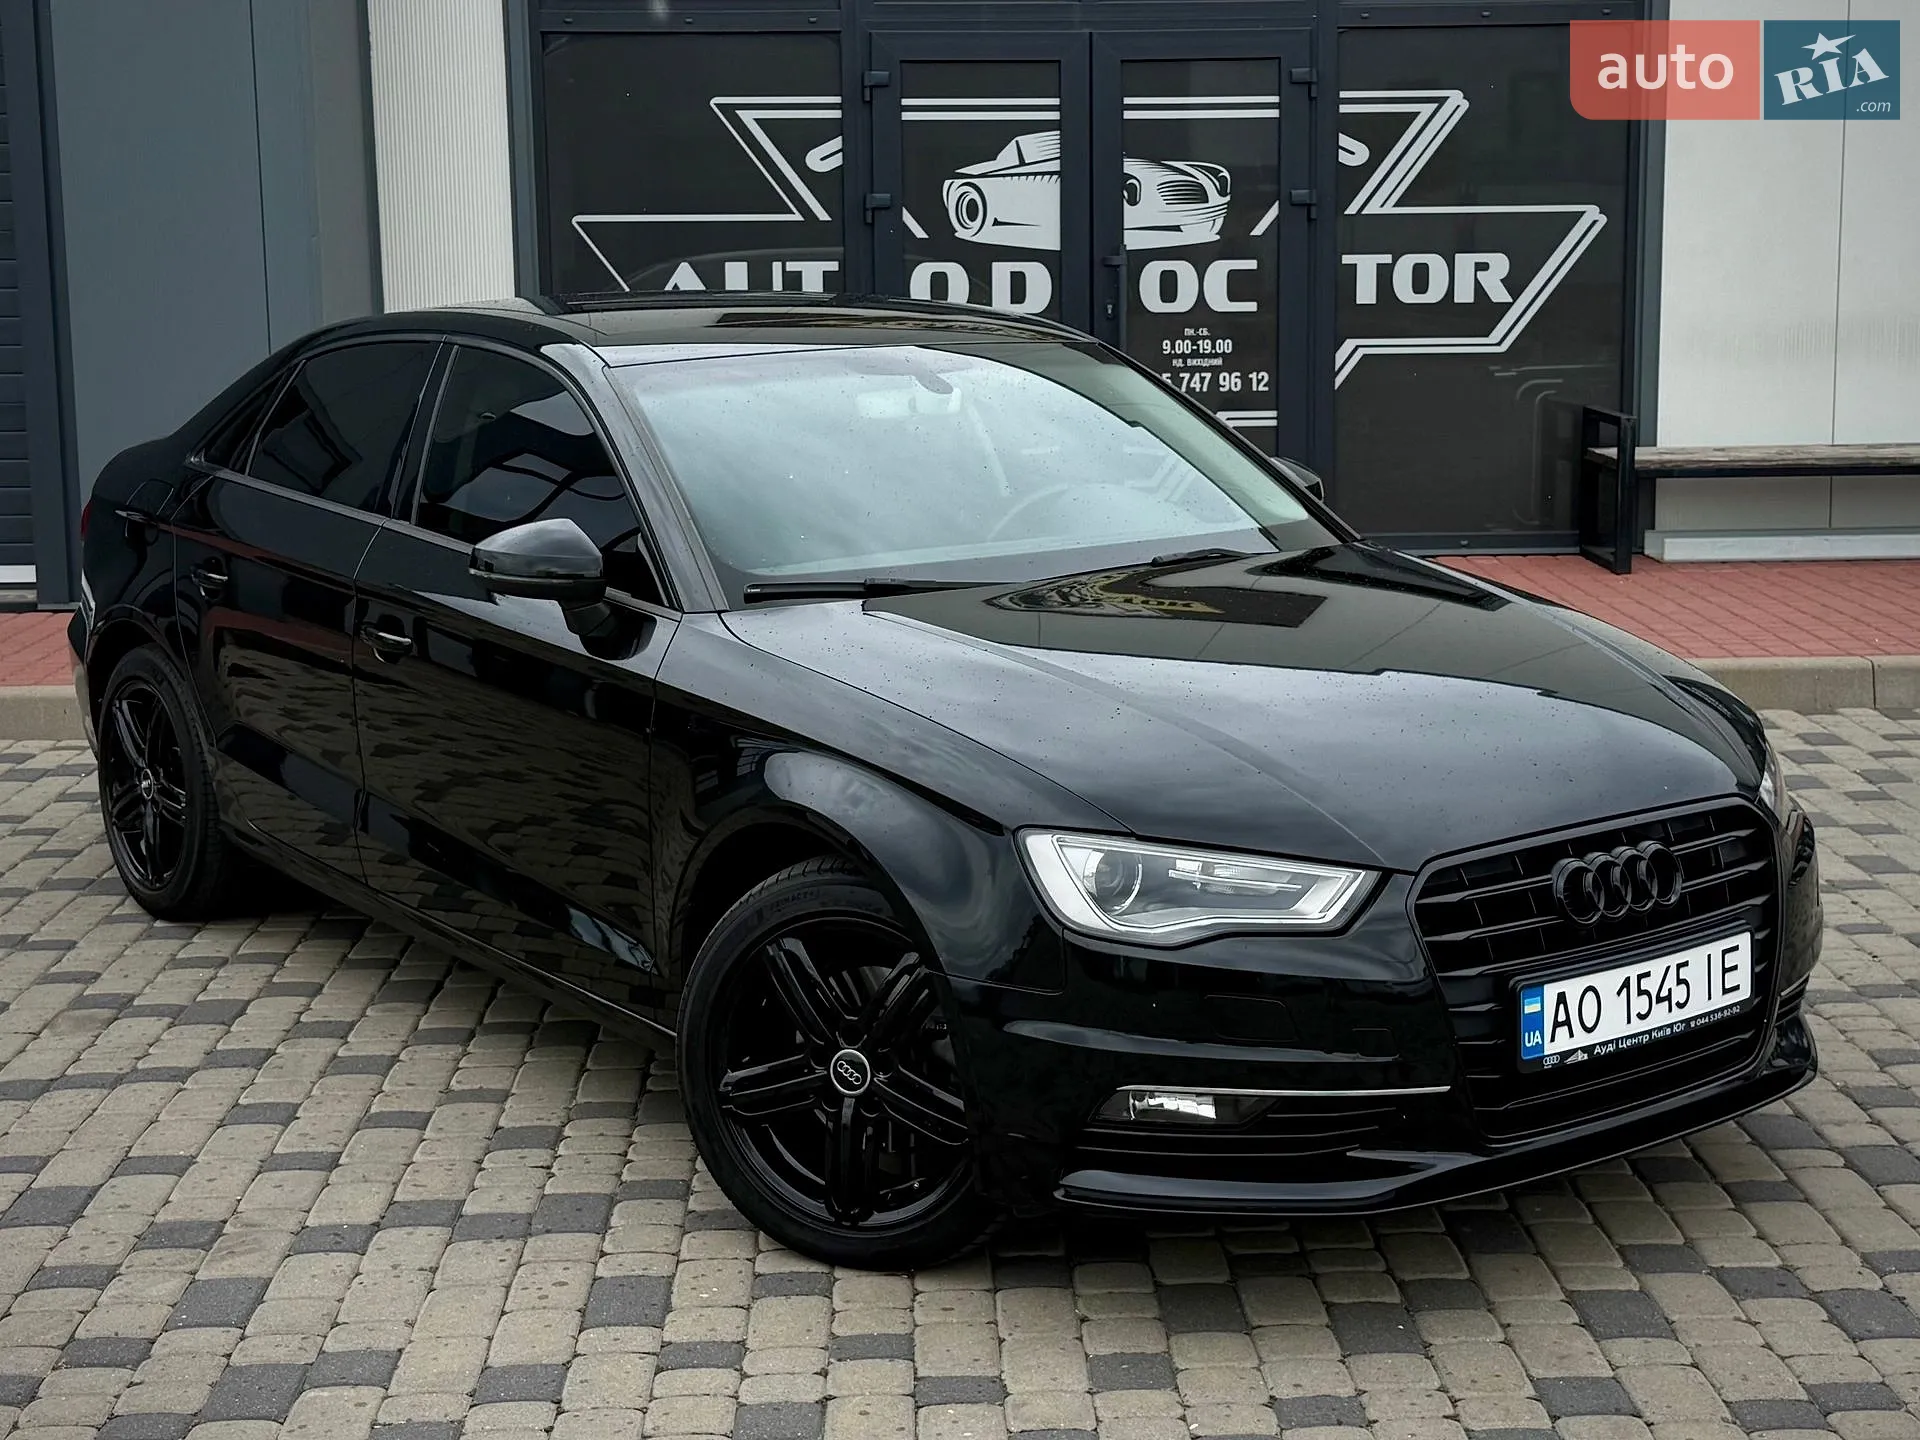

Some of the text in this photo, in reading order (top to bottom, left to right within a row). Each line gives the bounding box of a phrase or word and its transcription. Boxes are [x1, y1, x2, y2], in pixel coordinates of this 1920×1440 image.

[1162, 339, 1233, 354] 9.00-19.00
[1179, 372, 1212, 392] 747
[1219, 371, 1242, 392] 96
[1248, 371, 1270, 392] 12
[1549, 944, 1741, 1043] AO 1545 IE
[1524, 1030, 1543, 1048] UA
[1593, 1038, 1617, 1056] Ауді
[1618, 1034, 1650, 1049] Центр
[1651, 1026, 1672, 1040] Київ
[1672, 1023, 1686, 1033] Юг
[1696, 1016, 1709, 1026] 044
